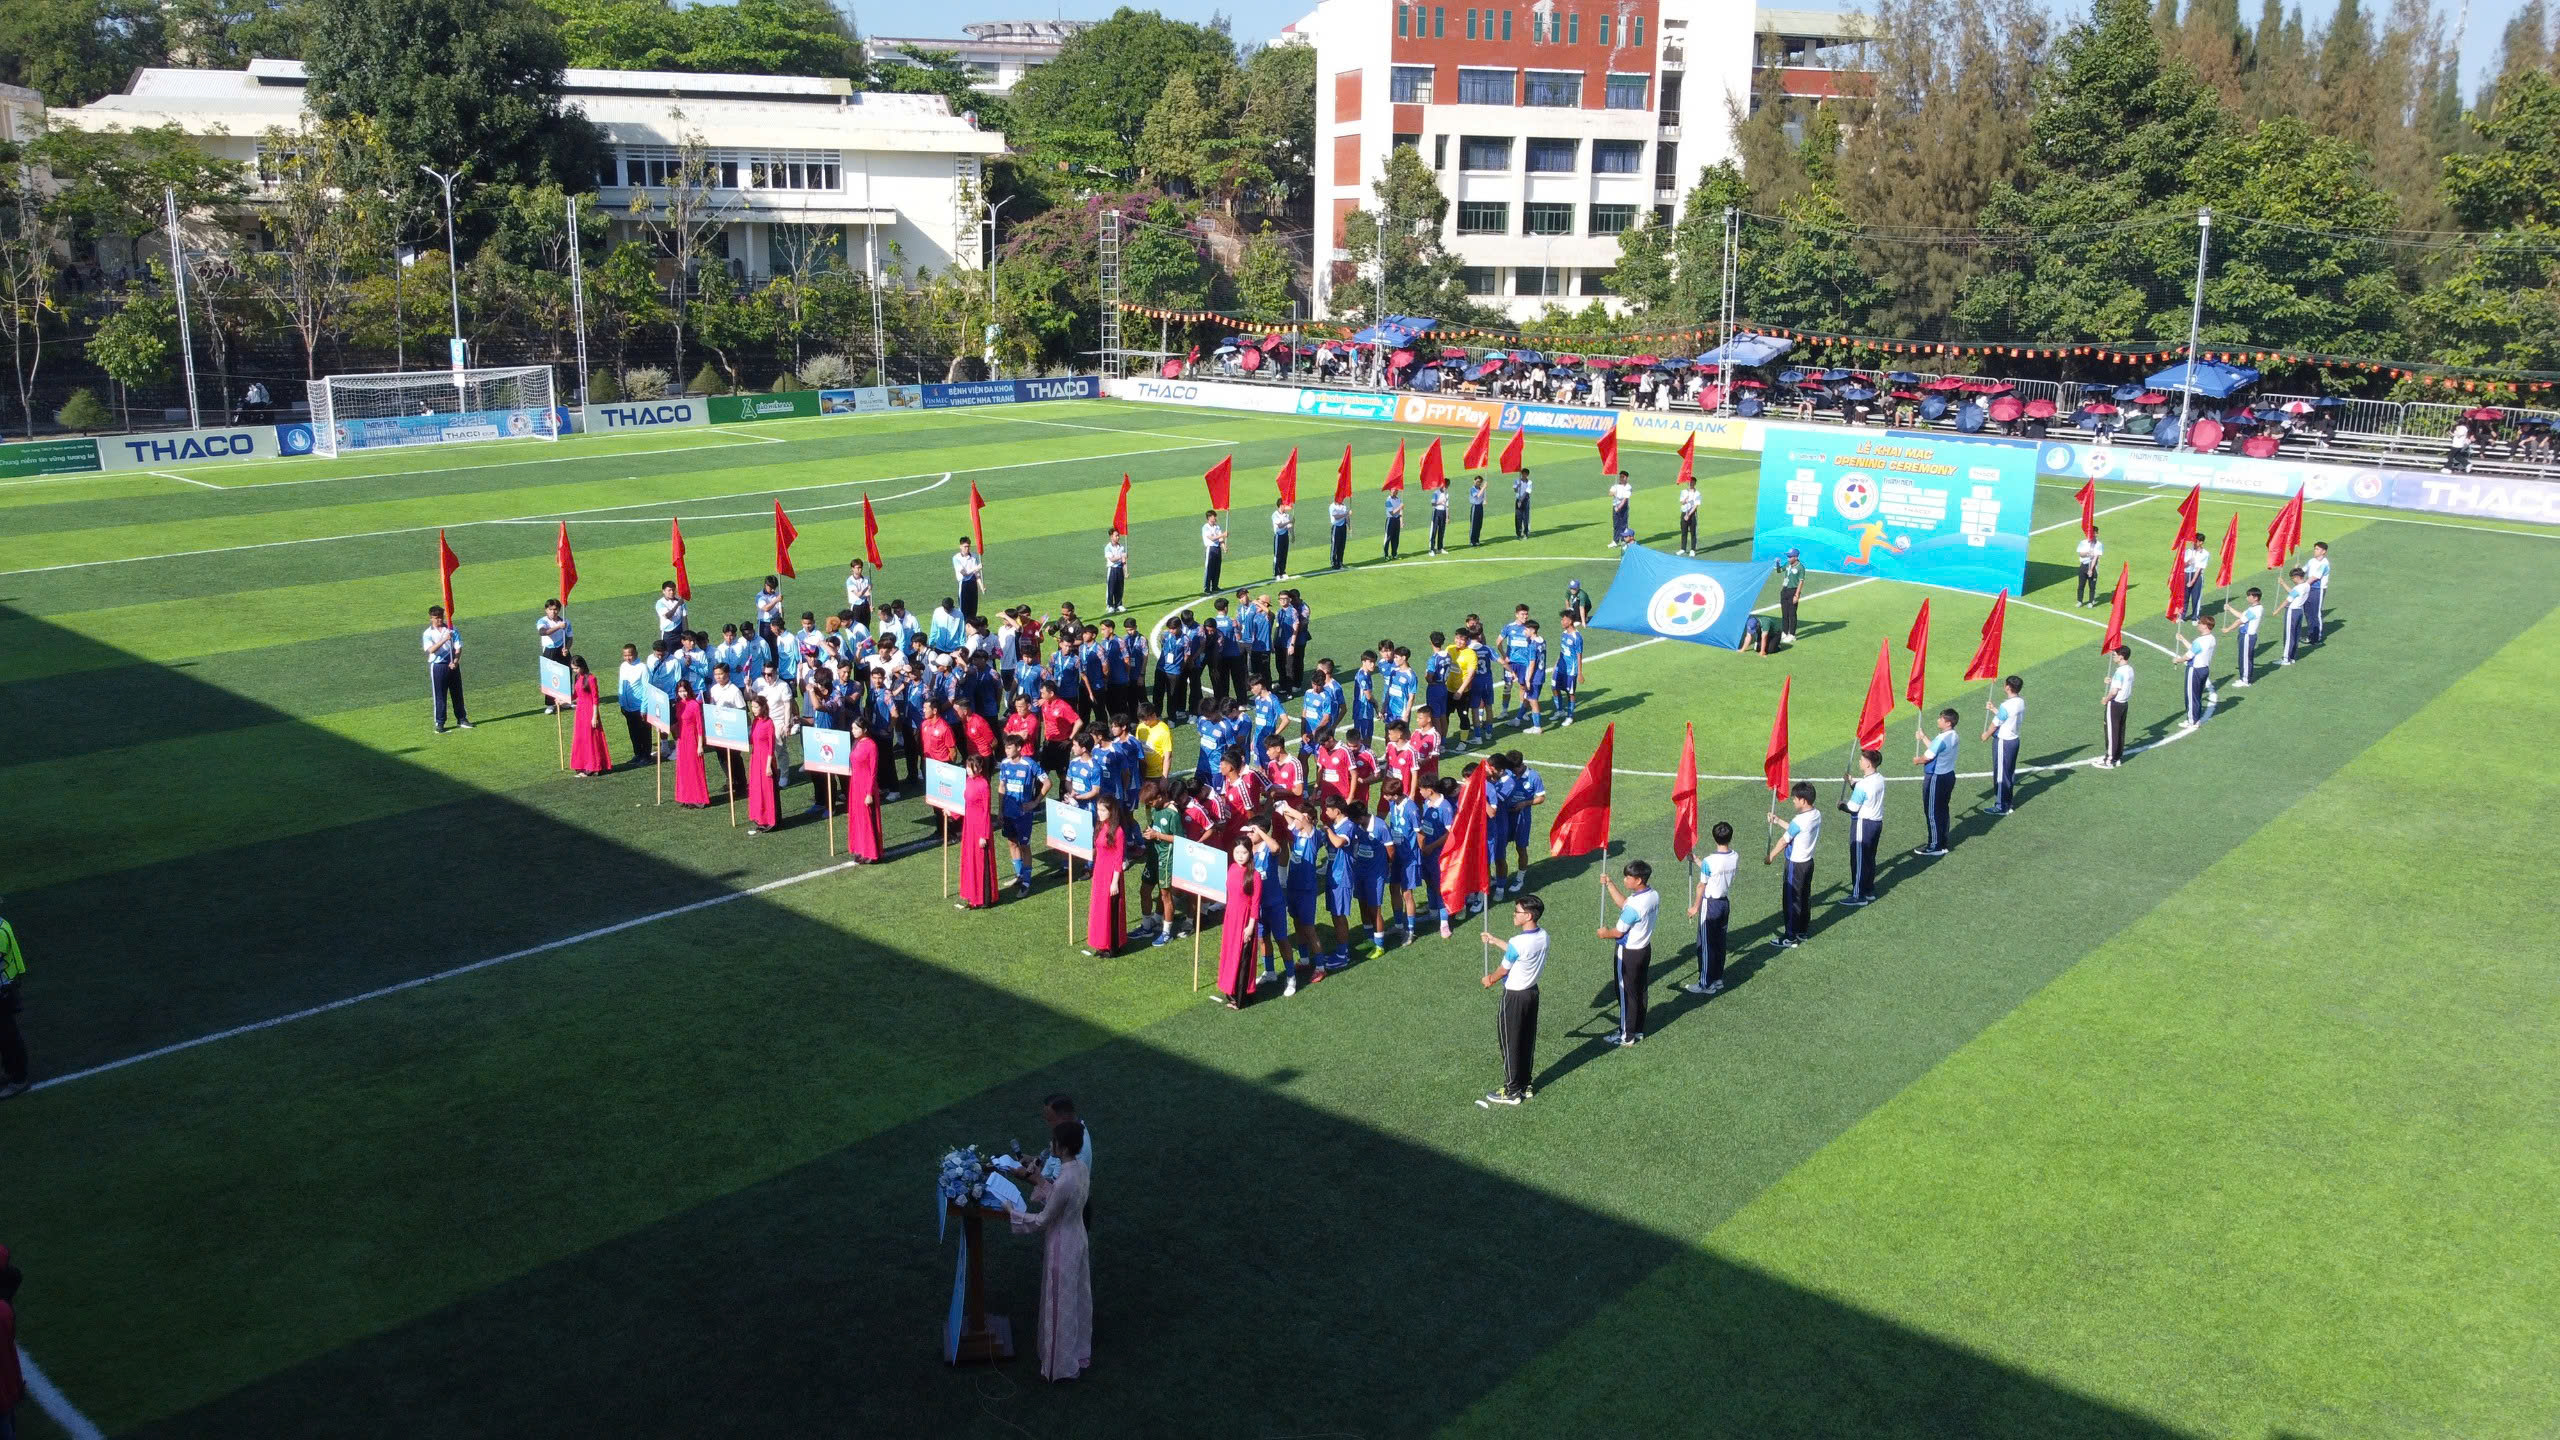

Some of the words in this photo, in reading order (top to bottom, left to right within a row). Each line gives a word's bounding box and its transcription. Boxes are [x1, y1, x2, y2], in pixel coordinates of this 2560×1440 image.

[994, 385, 1014, 393] KHOA
[1026, 380, 1089, 399] THACO
[1138, 383, 1198, 400] THACO
[977, 397, 991, 405] NHA
[991, 395, 1015, 403] TRANG
[601, 404, 692, 427] THACO
[1425, 403, 1456, 420] FPT
[1455, 405, 1488, 427] Play
[1633, 416, 1668, 429] NAM
[1684, 421, 1728, 433] BANK
[445, 431, 480, 439] THACO
[125, 433, 254, 463] THACO
[1834, 455, 1887, 470] OPENING
[1889, 460, 1958, 476] CEREMONY
